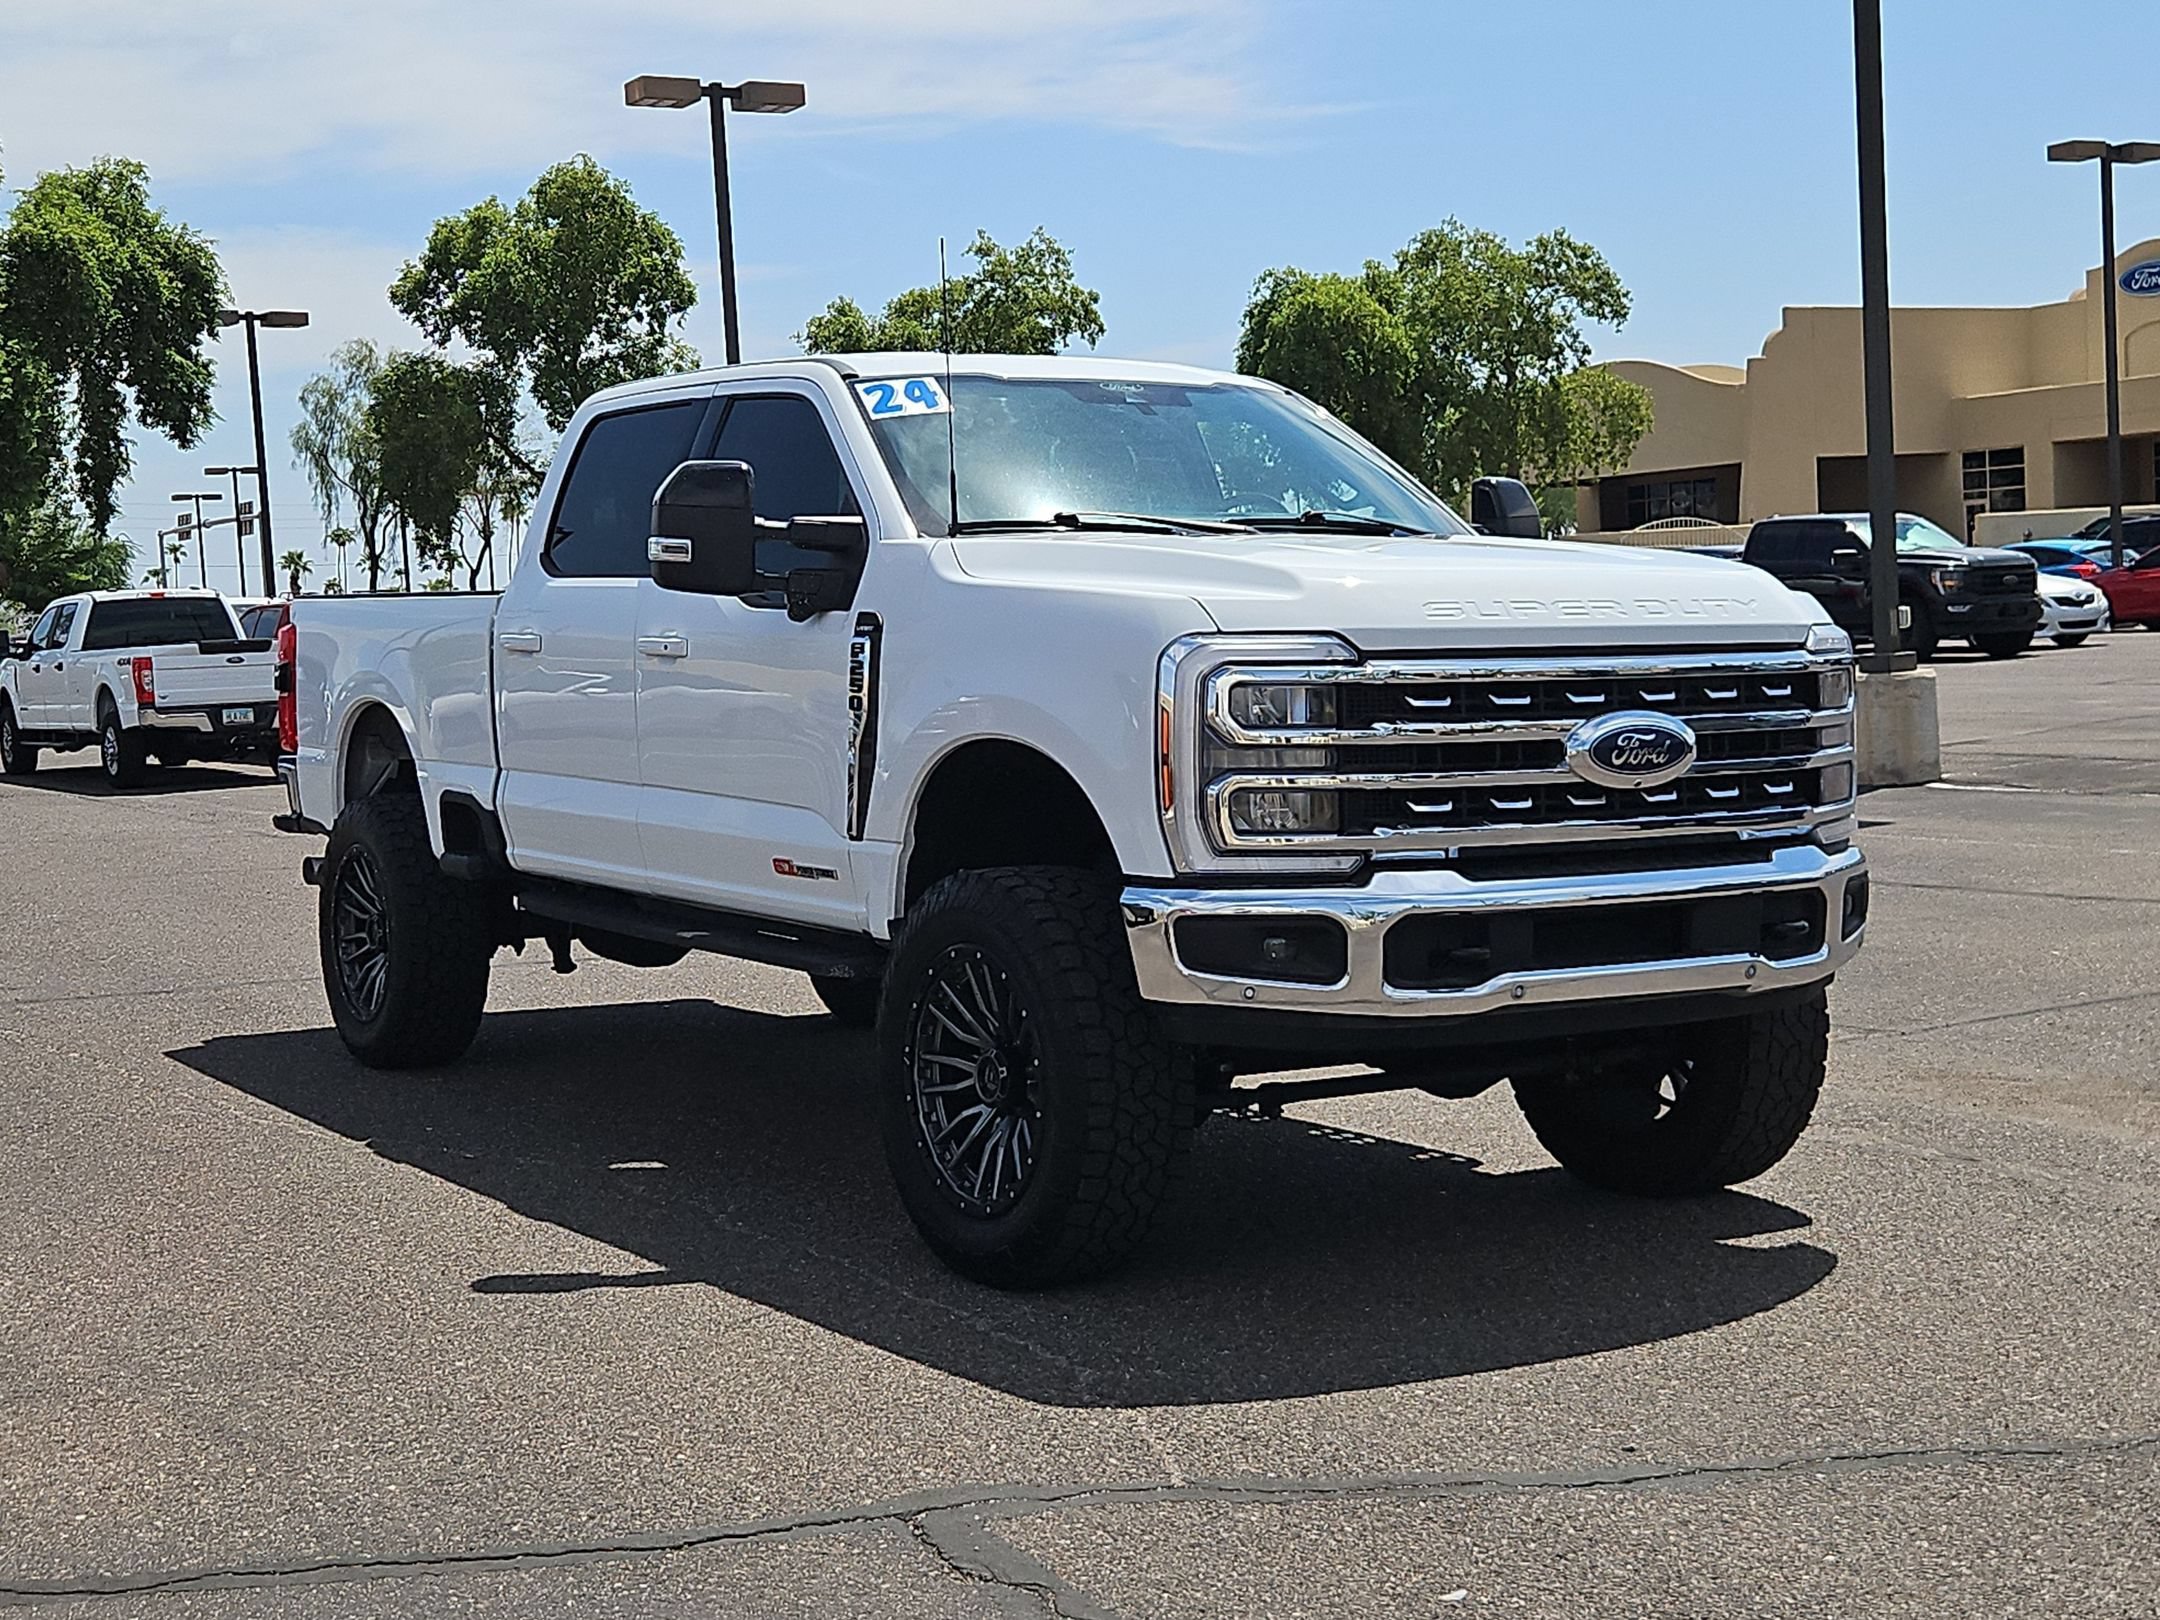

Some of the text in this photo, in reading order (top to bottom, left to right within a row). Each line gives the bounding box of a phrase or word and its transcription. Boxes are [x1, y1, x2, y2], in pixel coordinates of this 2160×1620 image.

[2131, 266, 2160, 290] For
[862, 379, 940, 415] 24
[1421, 597, 1757, 620] SUPER DUTY
[1611, 732, 1672, 766] Ford
